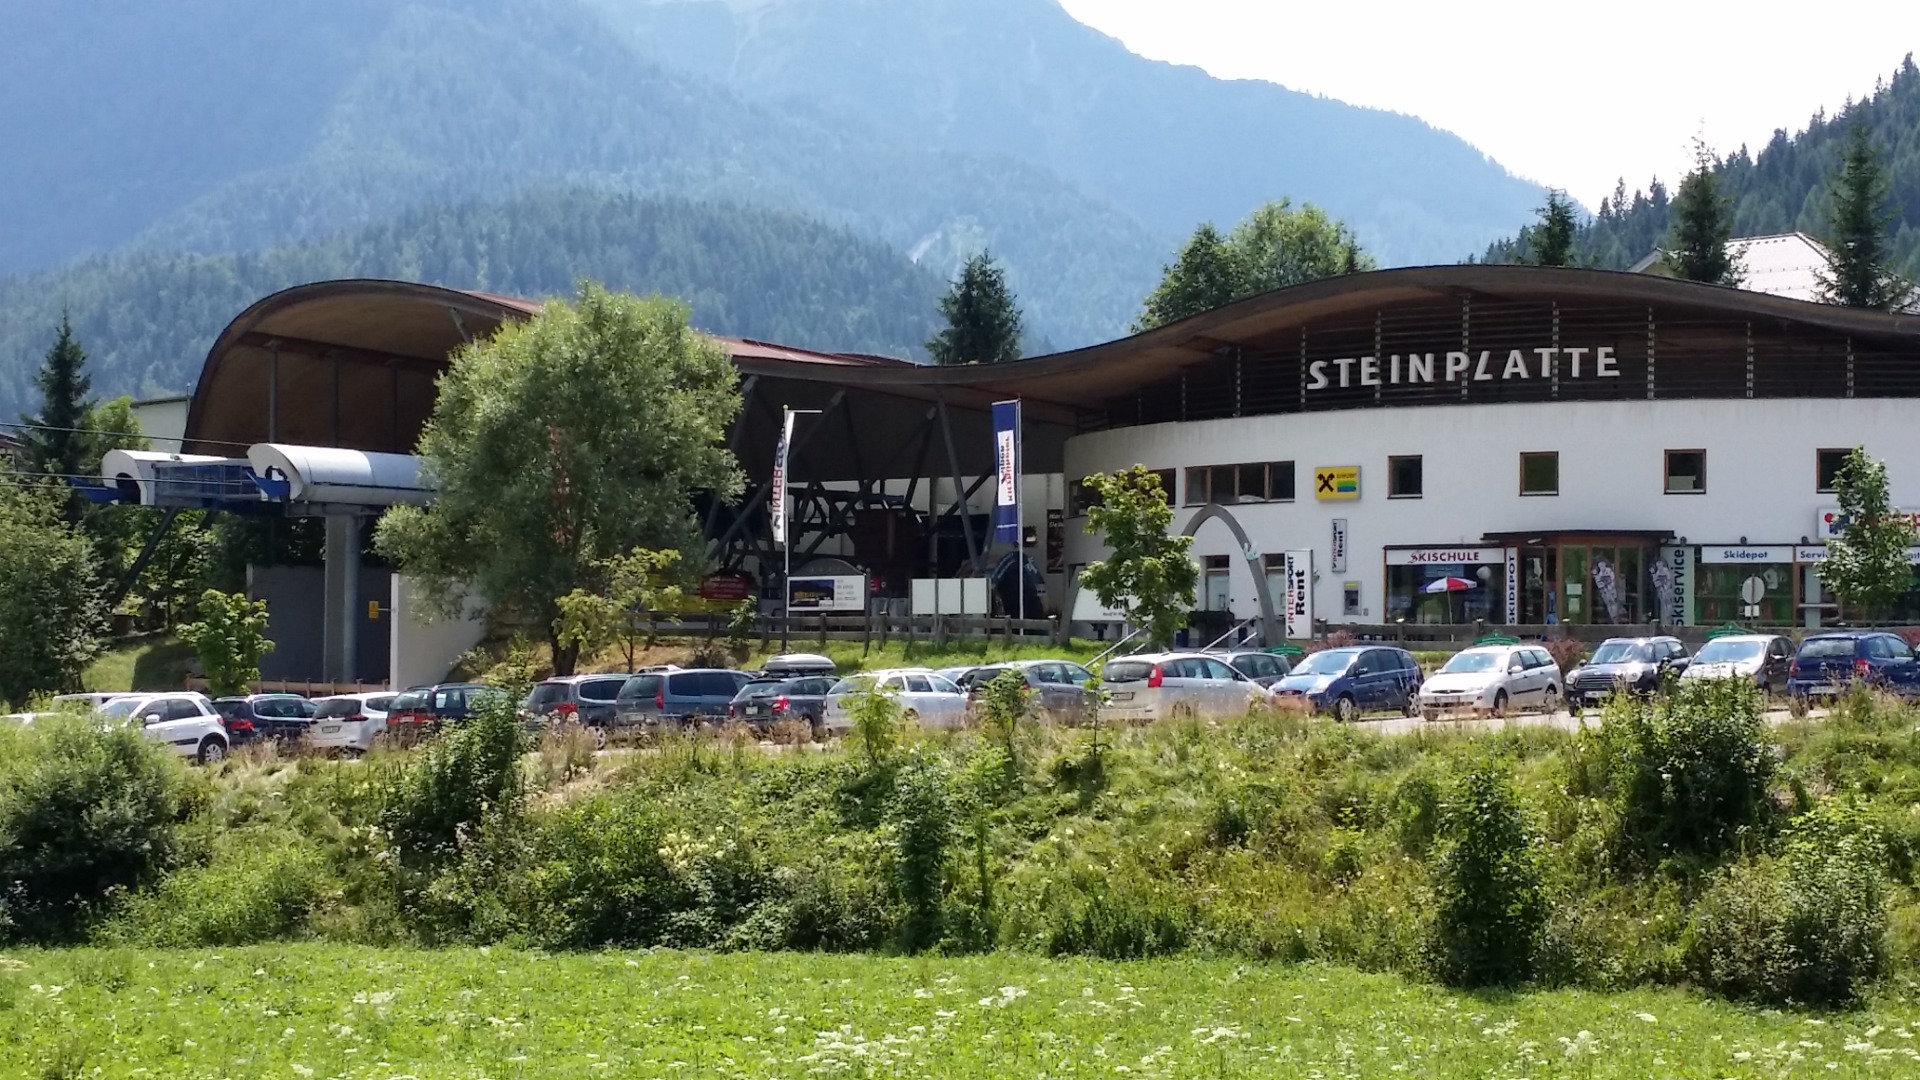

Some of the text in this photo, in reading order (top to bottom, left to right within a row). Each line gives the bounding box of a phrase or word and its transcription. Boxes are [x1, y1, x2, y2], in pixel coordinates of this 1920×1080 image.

[1306, 346, 1621, 389] STEINPLATTE
[1410, 551, 1480, 562] SKISCHULE
[1723, 550, 1768, 560] Skidepot
[1287, 554, 1295, 624] INTERSPORT
[1295, 569, 1305, 615] Rent
[1508, 555, 1516, 624] SKIDEPOT
